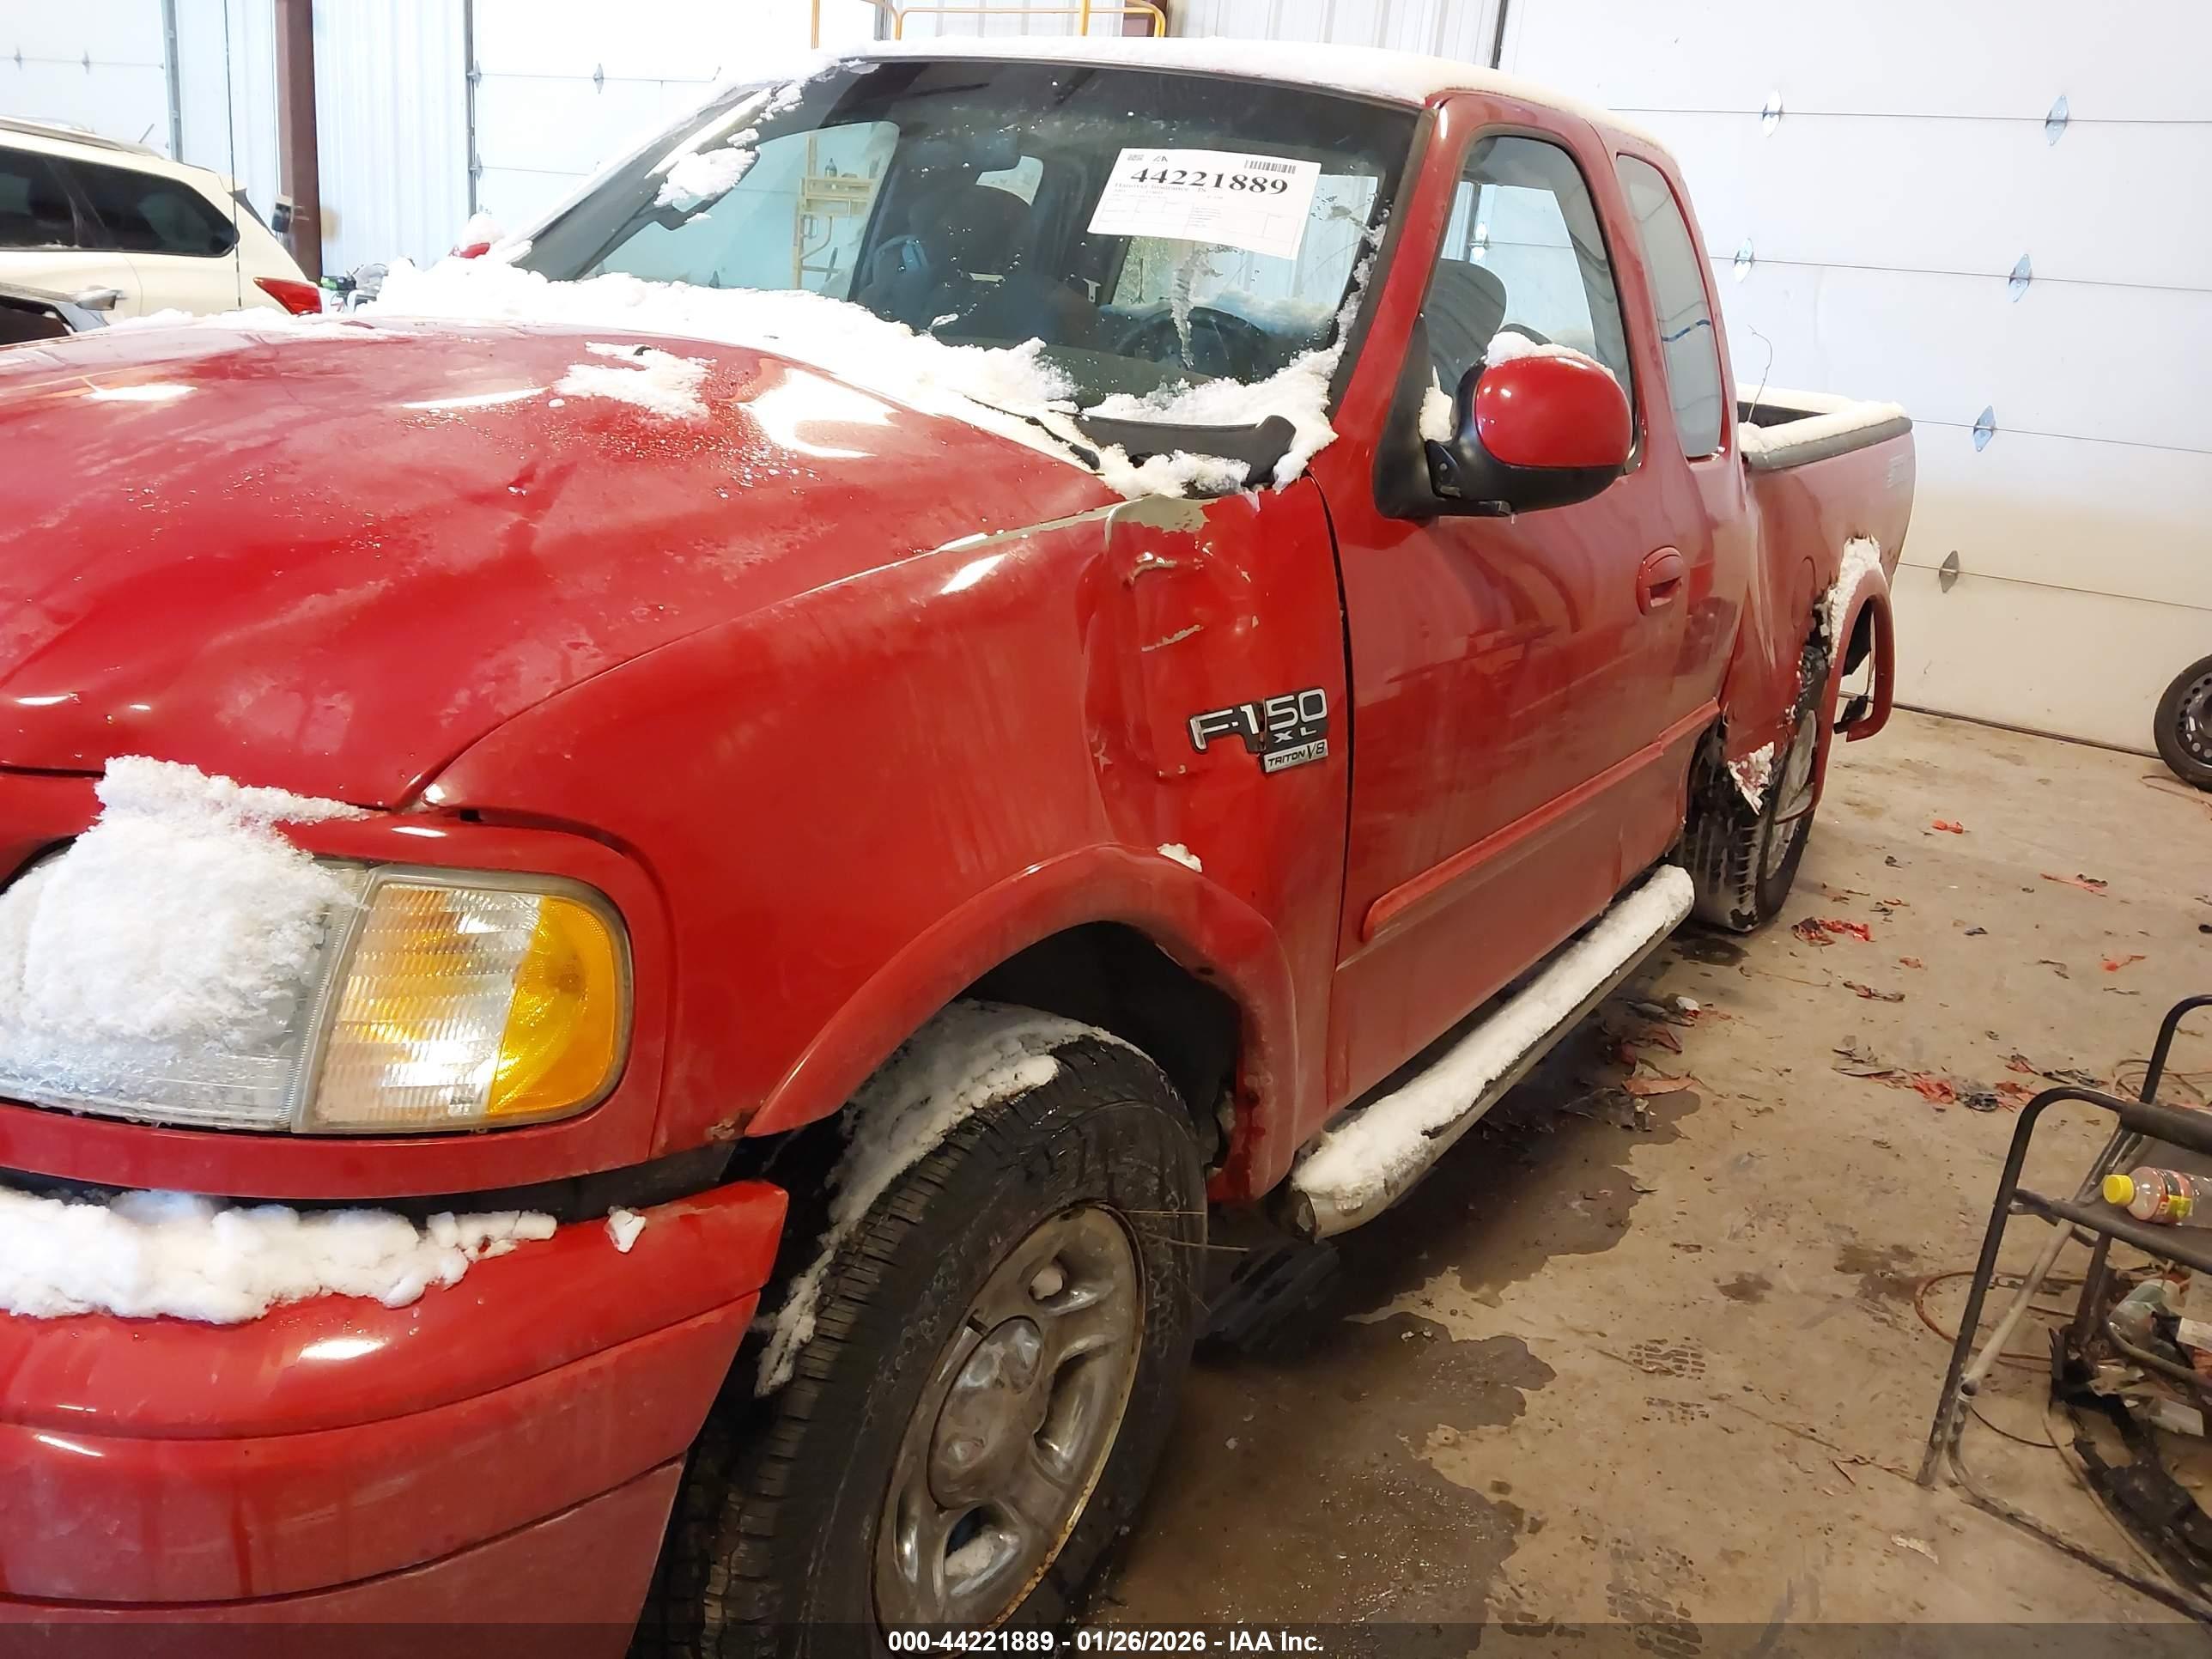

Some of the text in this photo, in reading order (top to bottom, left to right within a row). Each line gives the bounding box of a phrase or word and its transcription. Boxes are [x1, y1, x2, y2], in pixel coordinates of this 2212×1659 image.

[1131, 167, 1288, 195] 44221889
[1189, 688, 1328, 750] F-150
[1273, 726, 1317, 744] XL
[1267, 740, 1326, 768] TRITON V8
